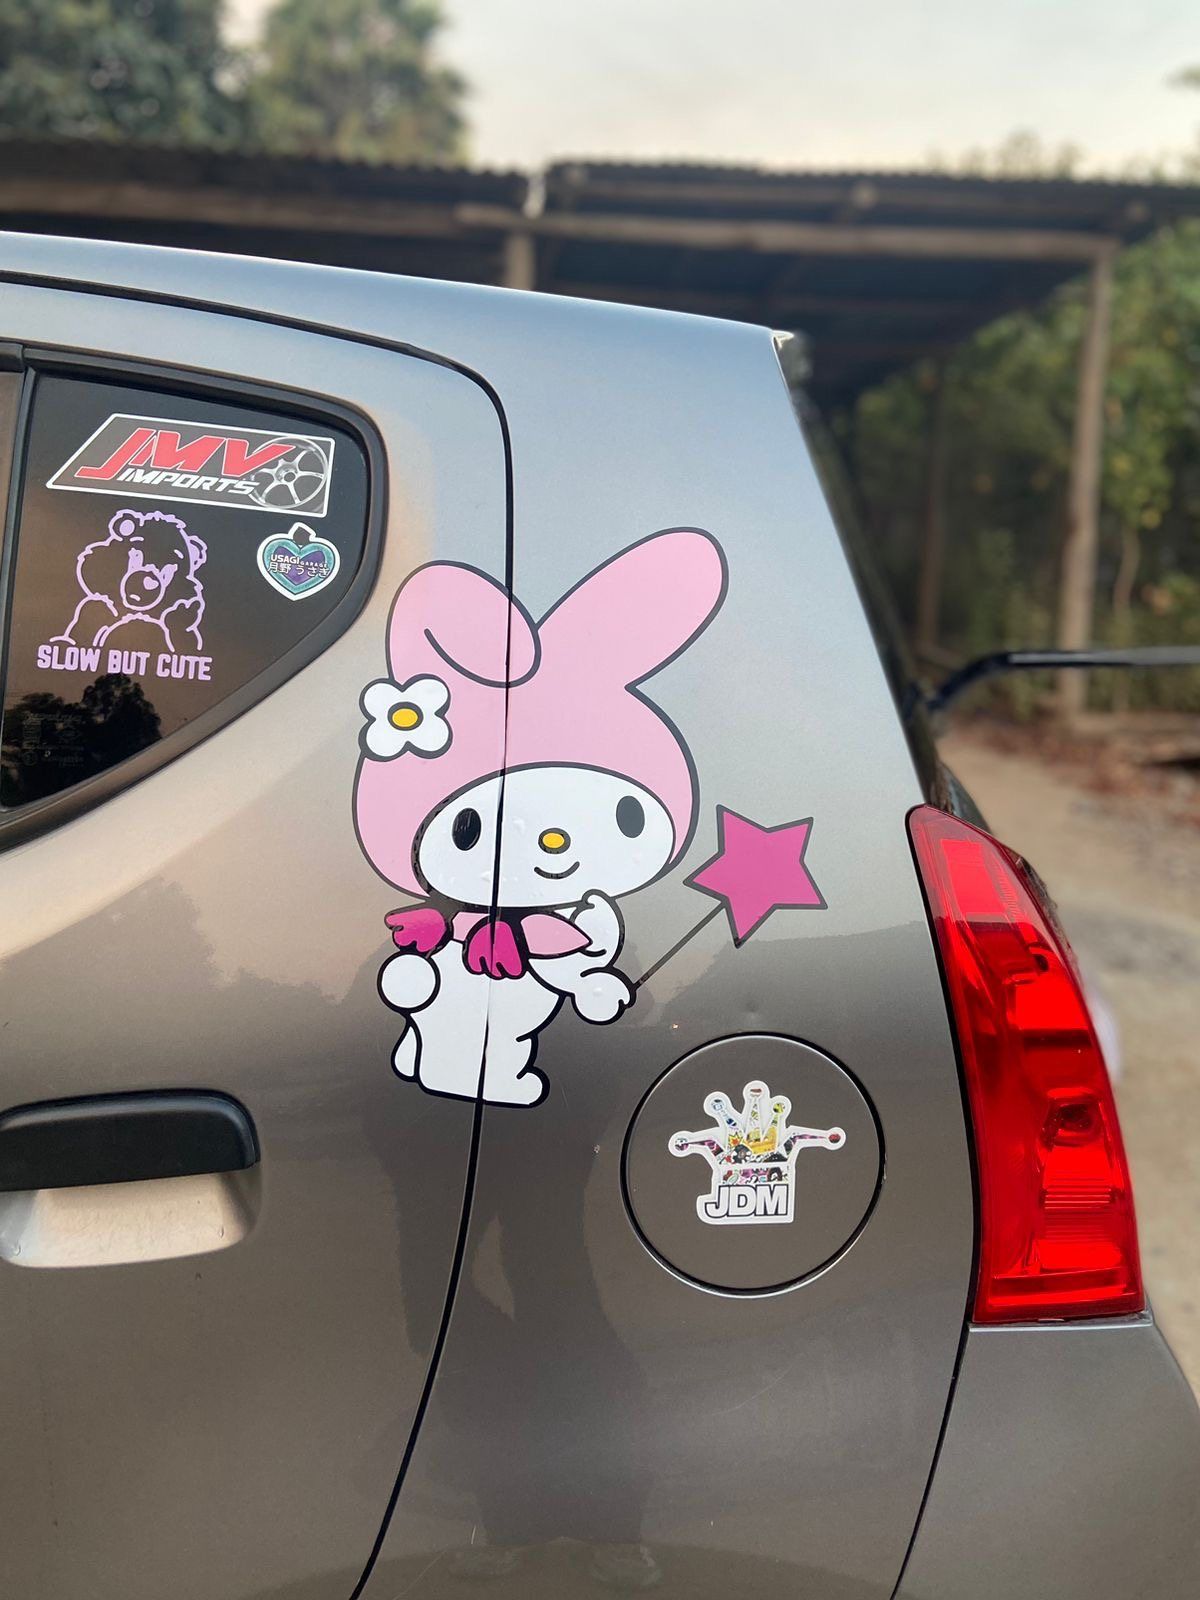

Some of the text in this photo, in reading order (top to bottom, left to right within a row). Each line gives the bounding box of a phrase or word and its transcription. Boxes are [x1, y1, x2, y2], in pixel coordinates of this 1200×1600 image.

[75, 427, 297, 479] JMV
[117, 468, 260, 495] IMPORTS
[271, 554, 327, 568] USAGI GARAGE
[37, 645, 212, 681] SLOW BUT CUTE
[705, 1184, 789, 1217] JDM
